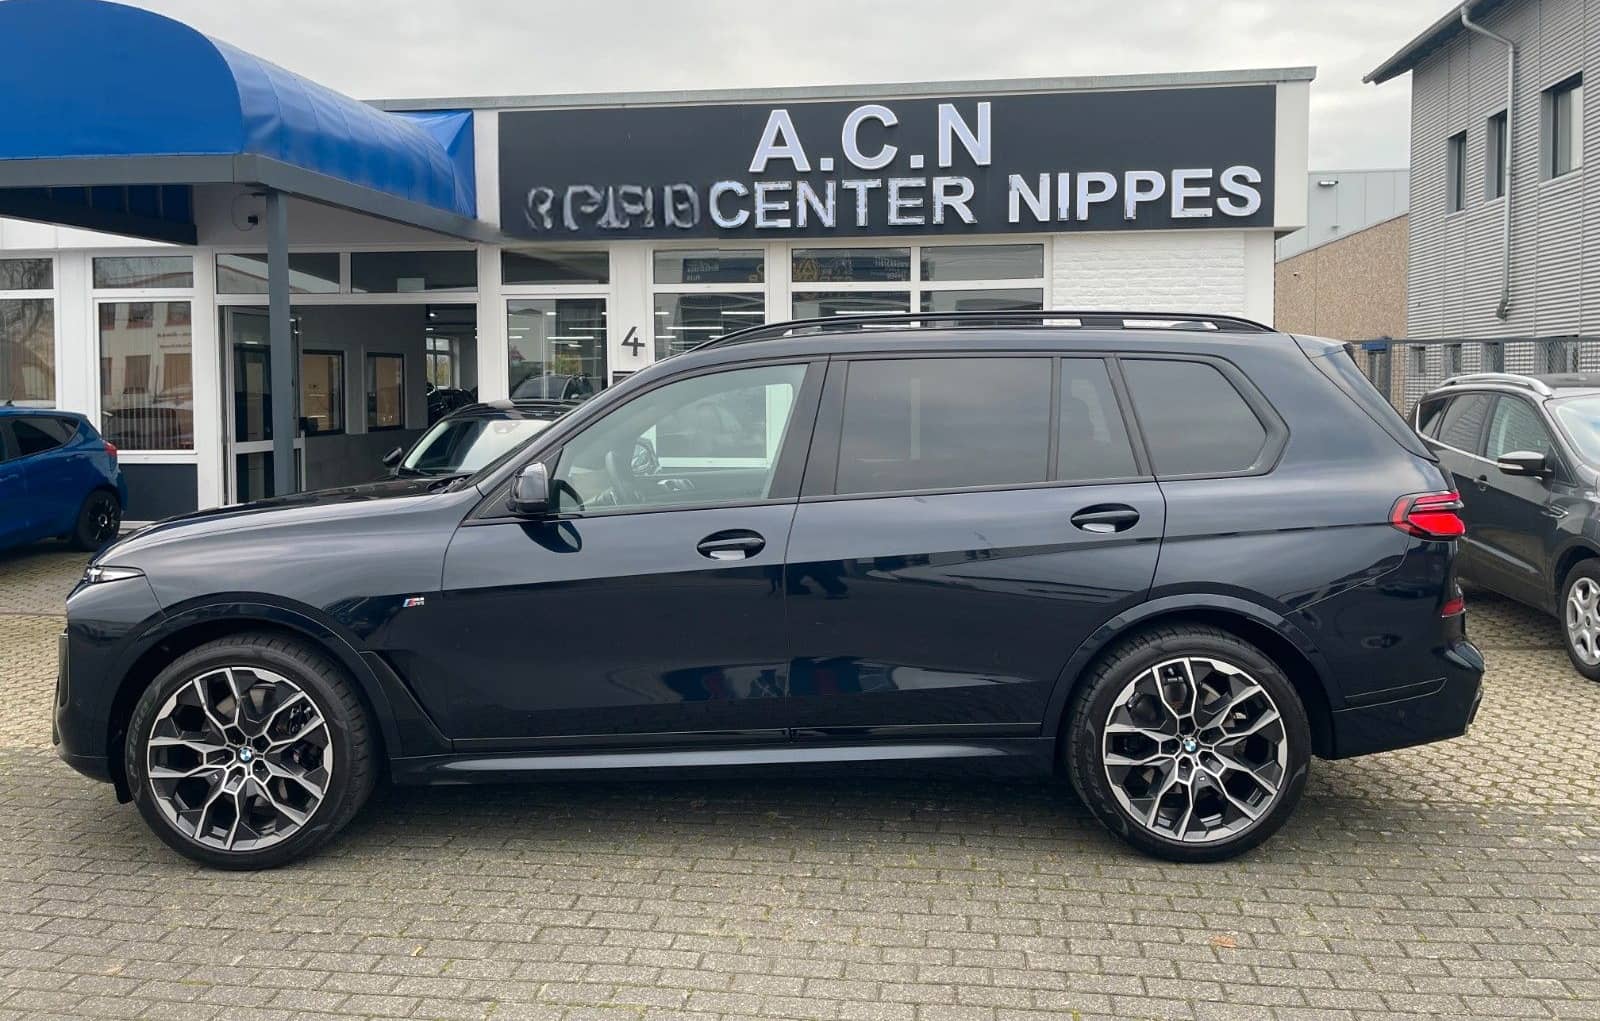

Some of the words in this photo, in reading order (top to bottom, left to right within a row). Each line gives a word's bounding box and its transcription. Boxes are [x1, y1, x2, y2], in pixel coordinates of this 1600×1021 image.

[748, 101, 992, 173] A.C.N
[708, 175, 978, 229] CENTER
[1007, 165, 1262, 224] NIPPES
[621, 326, 645, 357] 4
